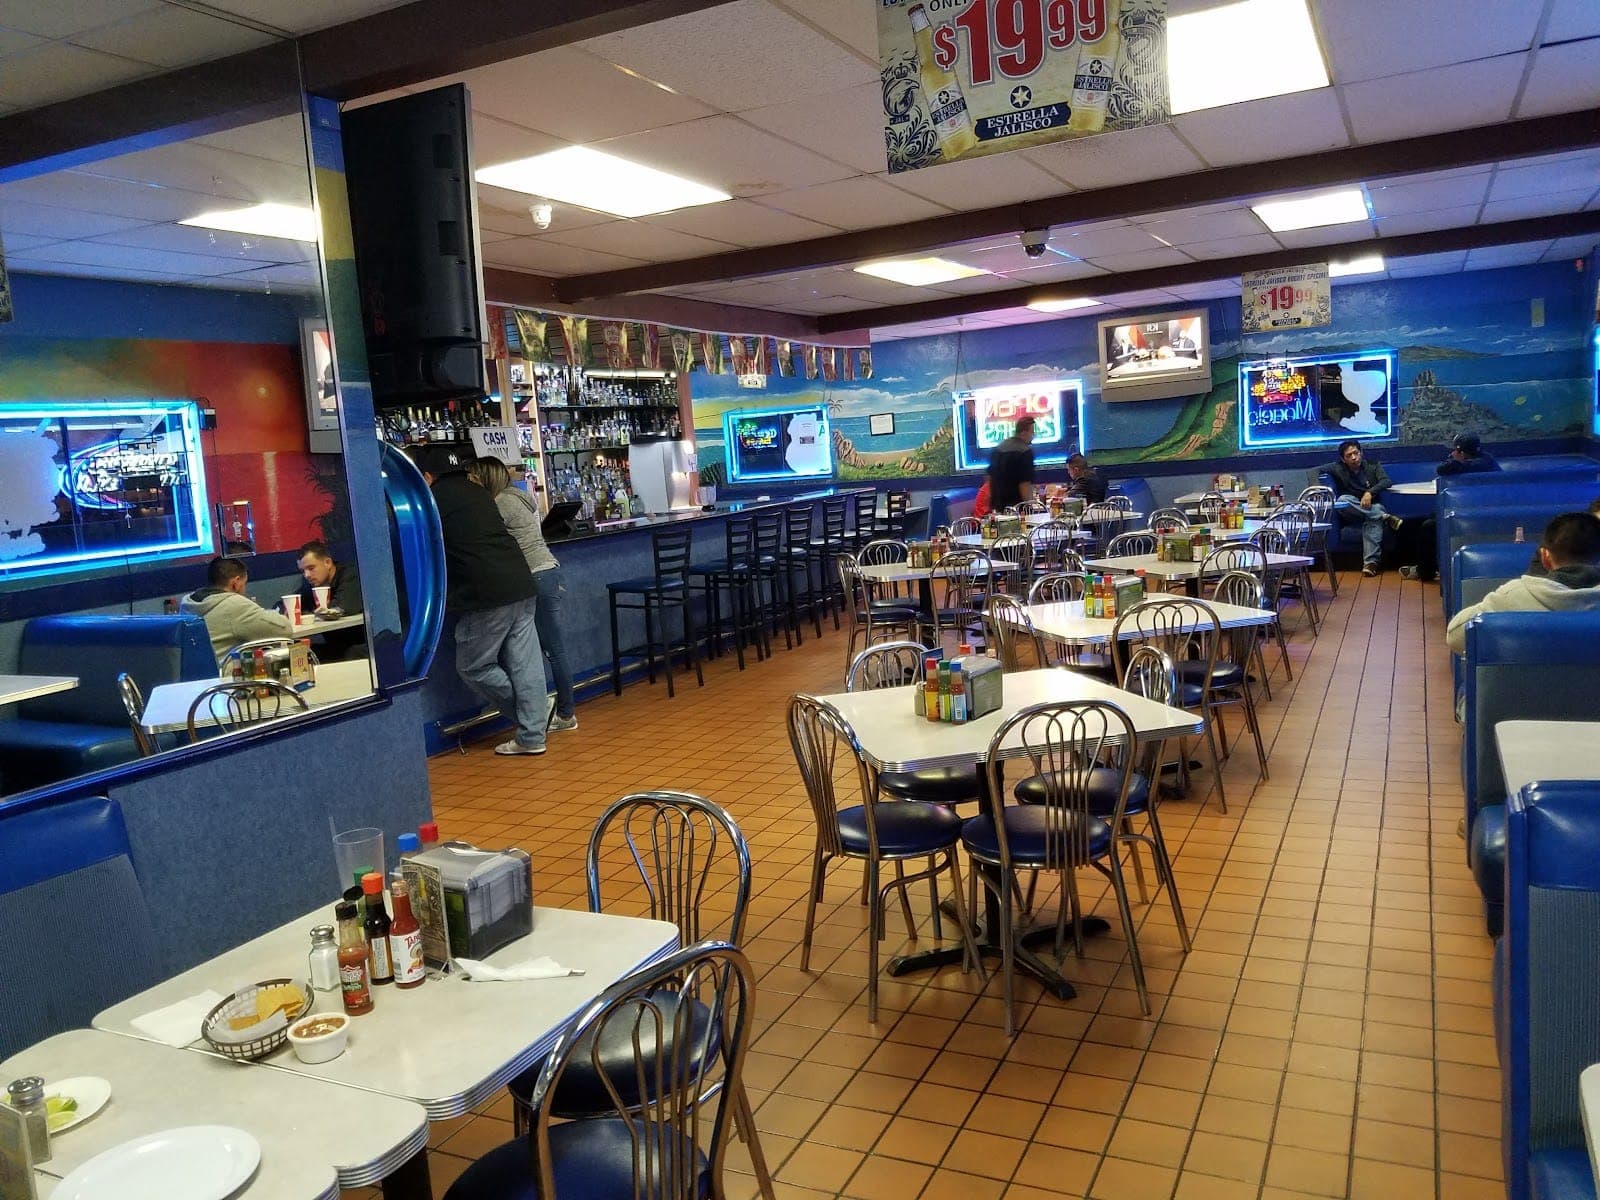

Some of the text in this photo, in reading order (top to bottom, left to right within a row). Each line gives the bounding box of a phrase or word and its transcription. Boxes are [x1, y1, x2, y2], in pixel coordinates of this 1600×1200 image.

[987, 105, 1059, 129] ESTRELLA
[994, 117, 1052, 137] JALISCO
[483, 431, 508, 446] CASH
